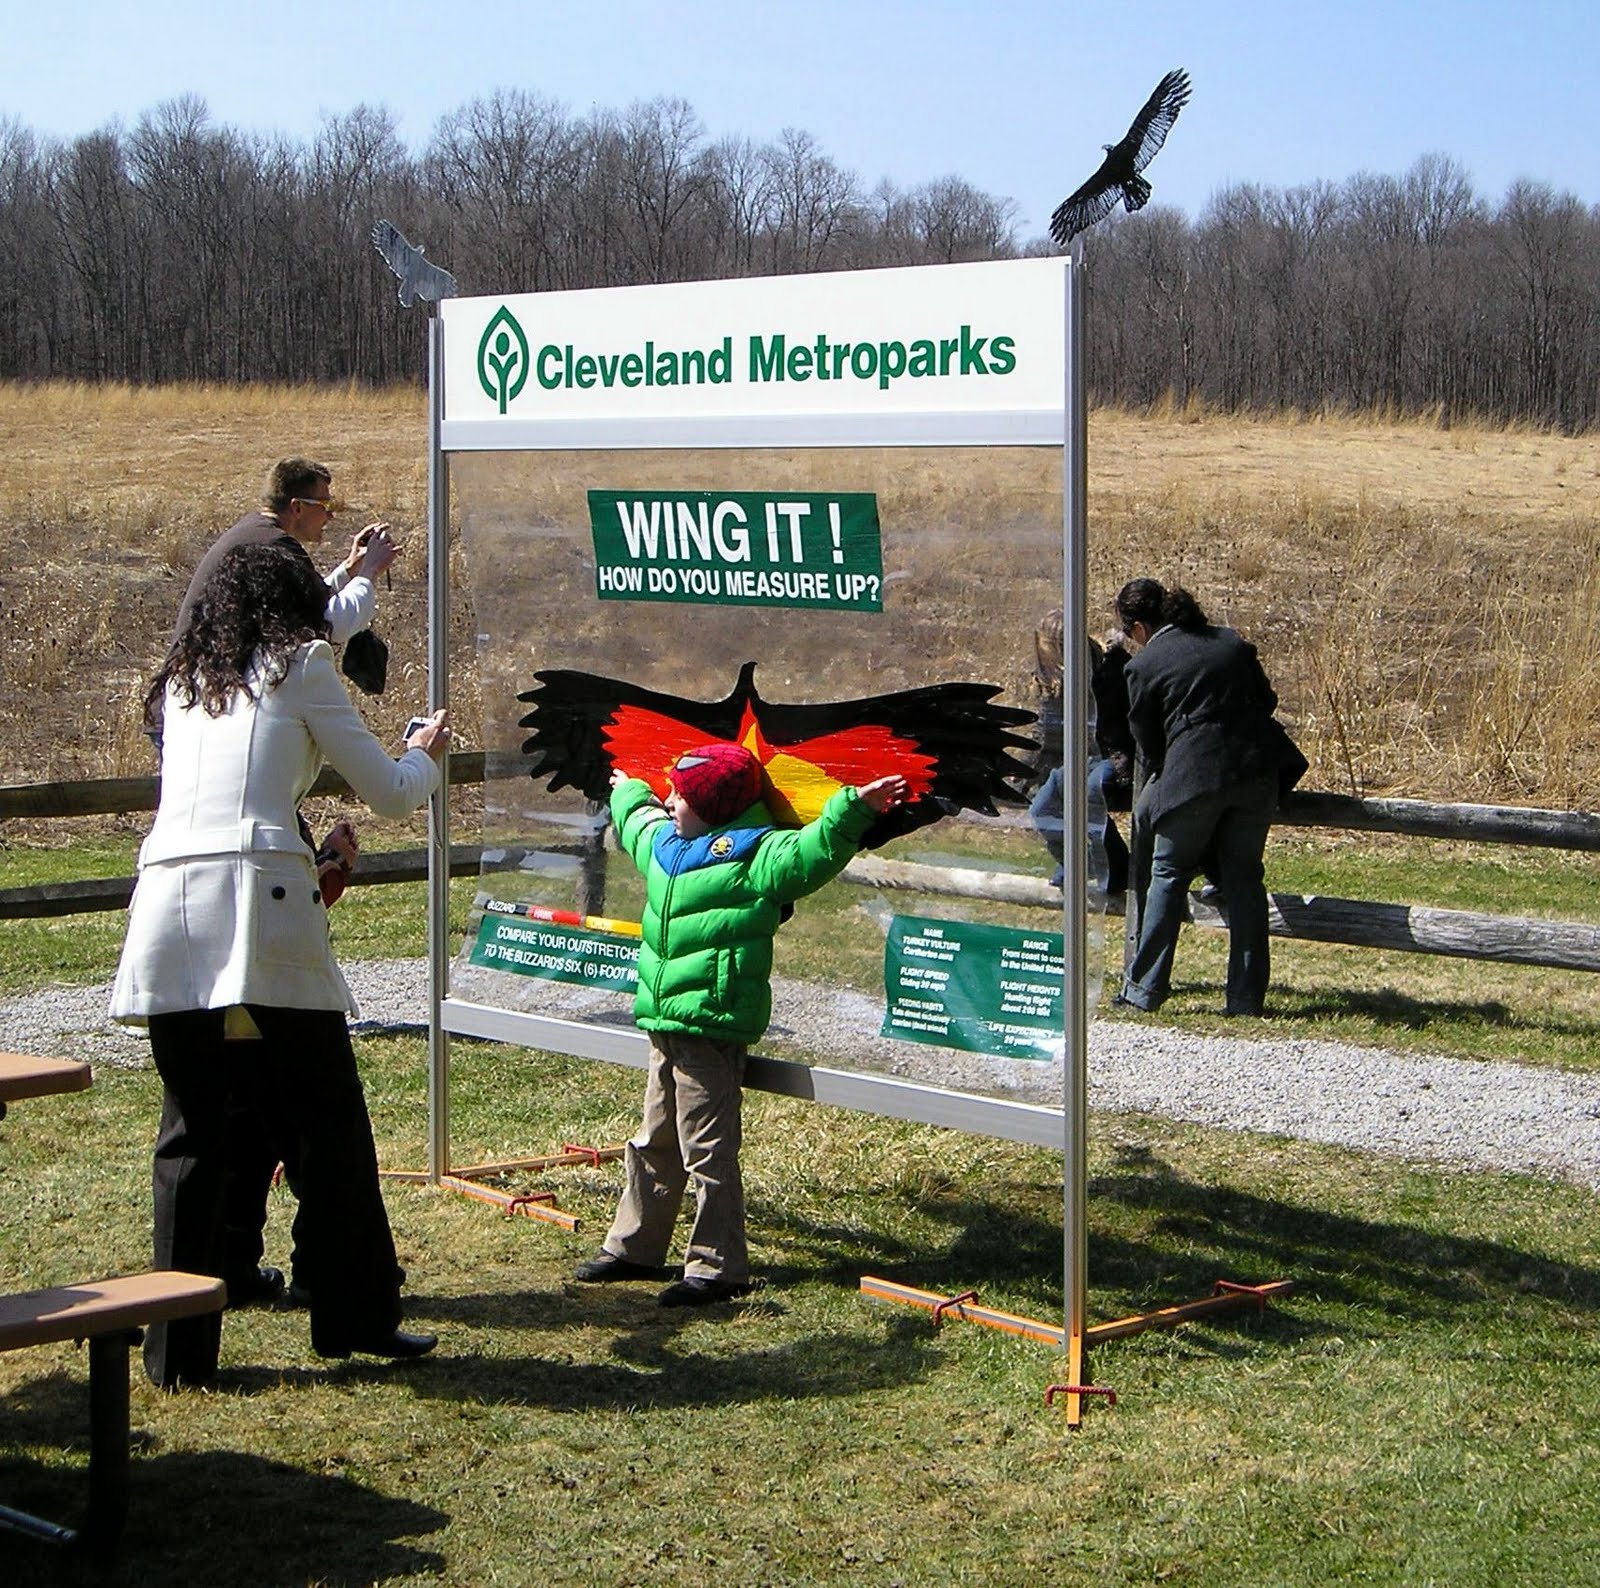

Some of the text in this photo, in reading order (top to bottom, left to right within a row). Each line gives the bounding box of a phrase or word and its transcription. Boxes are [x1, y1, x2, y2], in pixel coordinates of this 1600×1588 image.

[536, 324, 1018, 391] Cleveland Metroparks
[616, 500, 844, 564] WING IT !
[599, 566, 880, 602] HOW DO YOU MEASURE UP?
[487, 900, 516, 913] BUZZARD
[923, 928, 944, 939] NAME
[497, 925, 641, 962] COMPARE YOUR OUTSTRETCHE
[903, 936, 961, 952] TURKEY VULTURE
[1023, 940, 1049, 952] RANGE
[484, 943, 497, 958] TO
[498, 945, 515, 962] THE
[564, 958, 582, 974] SIX
[583, 961, 598, 979] (6)
[599, 963, 628, 981] FOOT
[626, 968, 640, 983] WI
[1002, 948, 1066, 964] From coast to coas
[900, 966, 950, 982] FLIGHT SPEED
[1009, 961, 1021, 970] the
[1021, 962, 1045, 973] United
[1045, 964, 1065, 975] State
[1000, 981, 1061, 997] FLIGHT HEIGHTS
[1001, 1003, 1022, 1014] about
[988, 1020, 1006, 1033] LIFE
